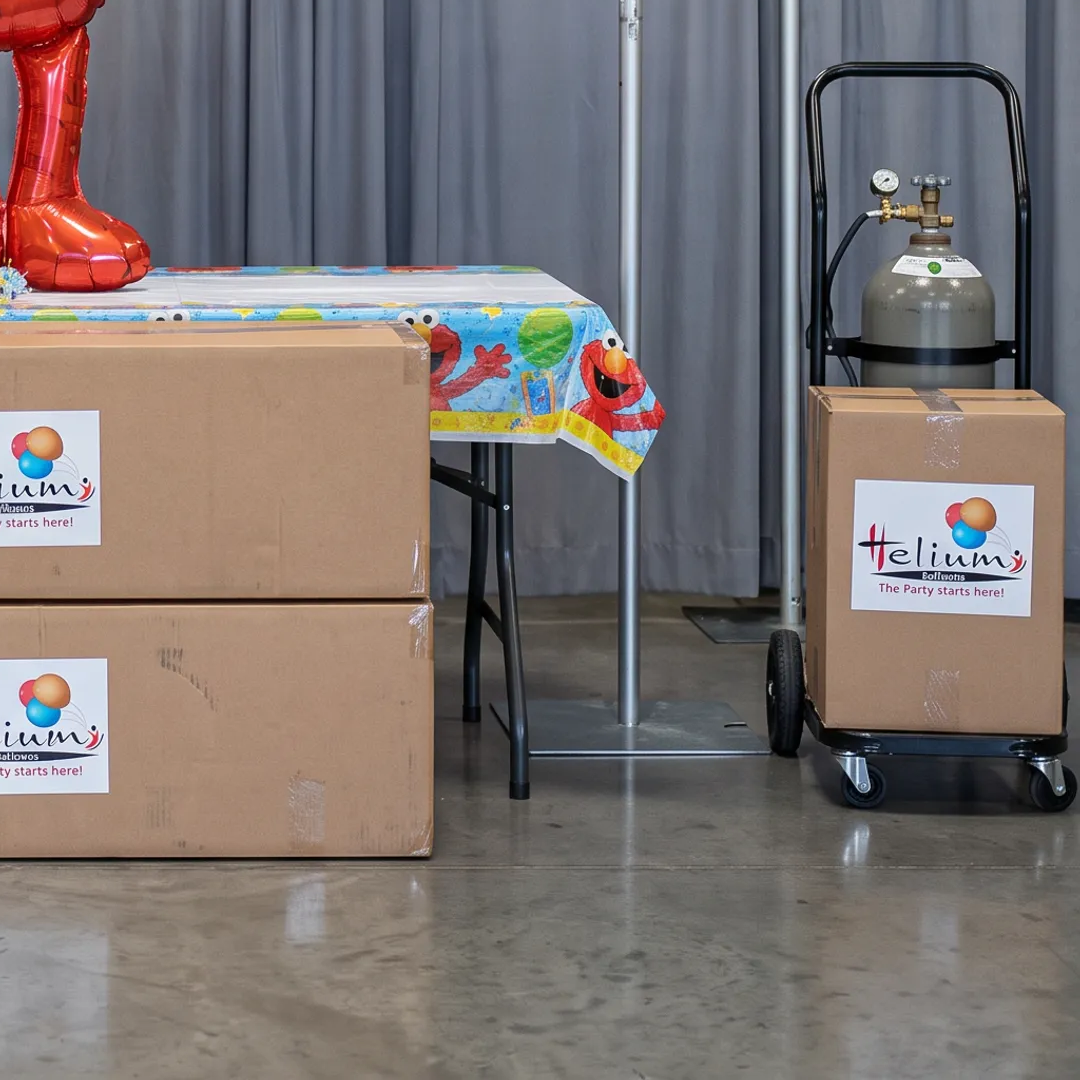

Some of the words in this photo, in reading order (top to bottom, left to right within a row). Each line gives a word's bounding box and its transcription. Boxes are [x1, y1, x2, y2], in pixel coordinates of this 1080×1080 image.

[5, 517, 39, 528] starts
[43, 516, 73, 527] here!
[857, 521, 1013, 572] Helium
[879, 583, 900, 594] The
[903, 584, 934, 597] Party
[937, 585, 971, 597] starts
[974, 586, 1005, 598] here!
[14, 766, 48, 777] starts
[51, 765, 83, 776] here!
